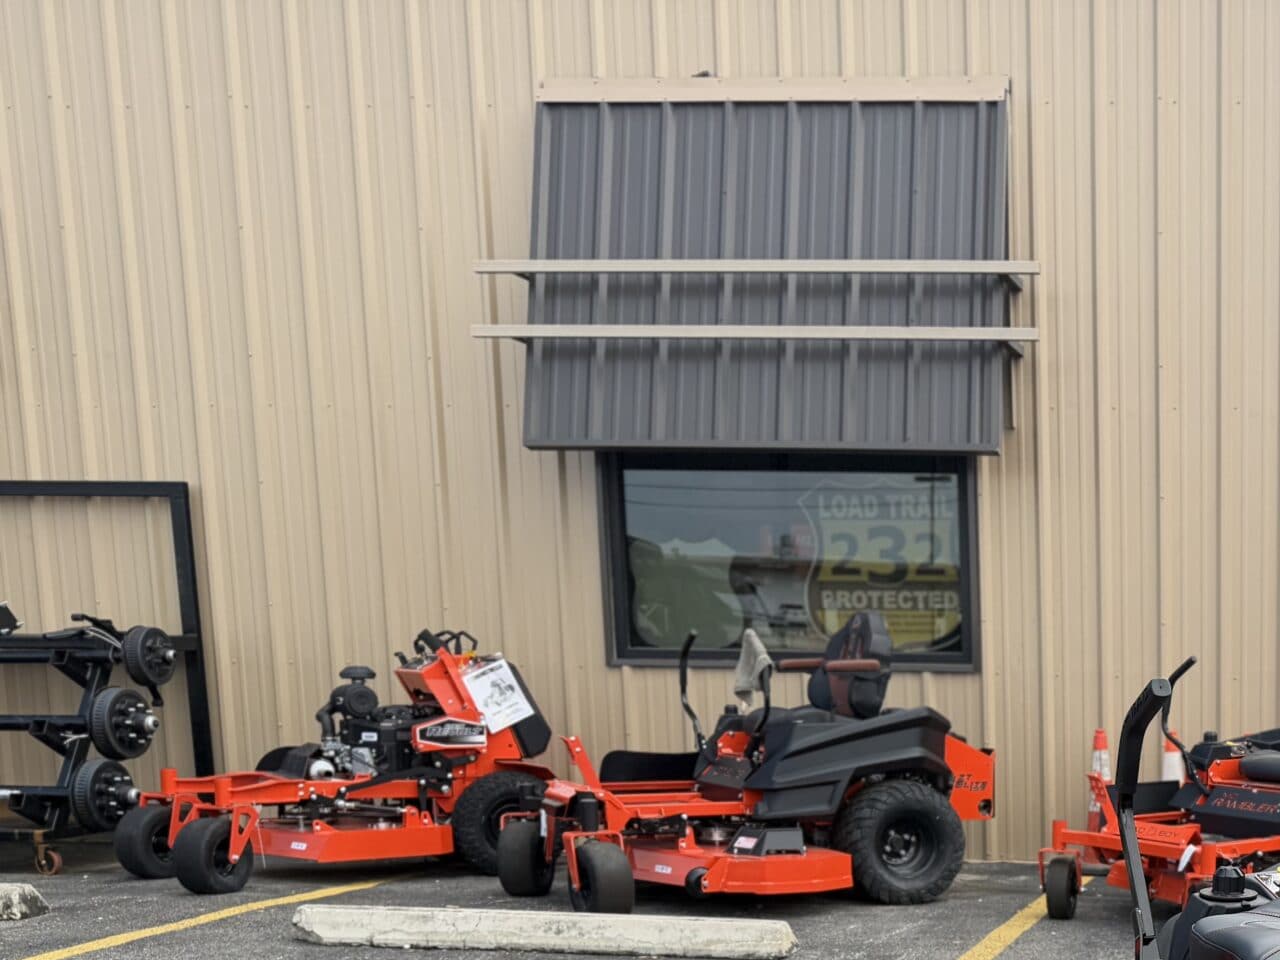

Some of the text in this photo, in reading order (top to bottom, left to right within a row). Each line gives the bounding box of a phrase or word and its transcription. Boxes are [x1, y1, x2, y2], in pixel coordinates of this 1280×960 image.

[818, 493, 954, 519] LOAD TRAIL
[830, 525, 946, 584] 232
[820, 589, 960, 610] PROTECTED
